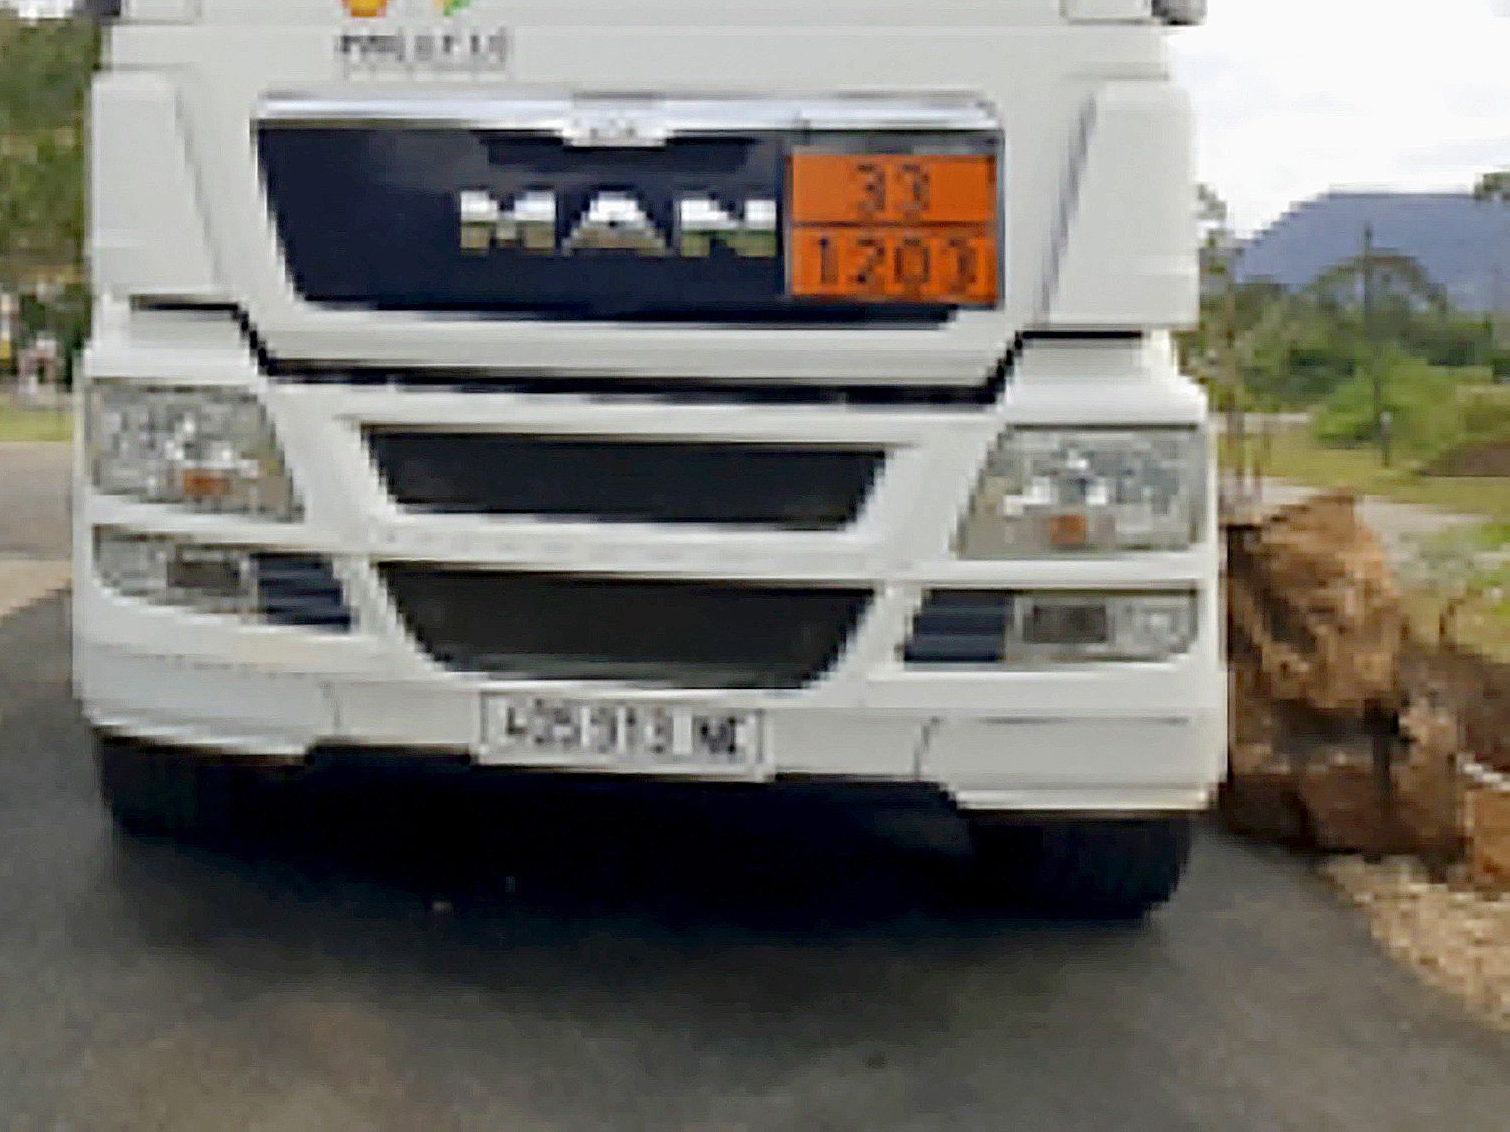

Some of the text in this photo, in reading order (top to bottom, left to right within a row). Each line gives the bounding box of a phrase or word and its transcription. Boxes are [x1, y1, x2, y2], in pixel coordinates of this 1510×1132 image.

[851, 162, 931, 217] 33
[459, 189, 777, 257] MAN
[815, 235, 978, 293] 1203
